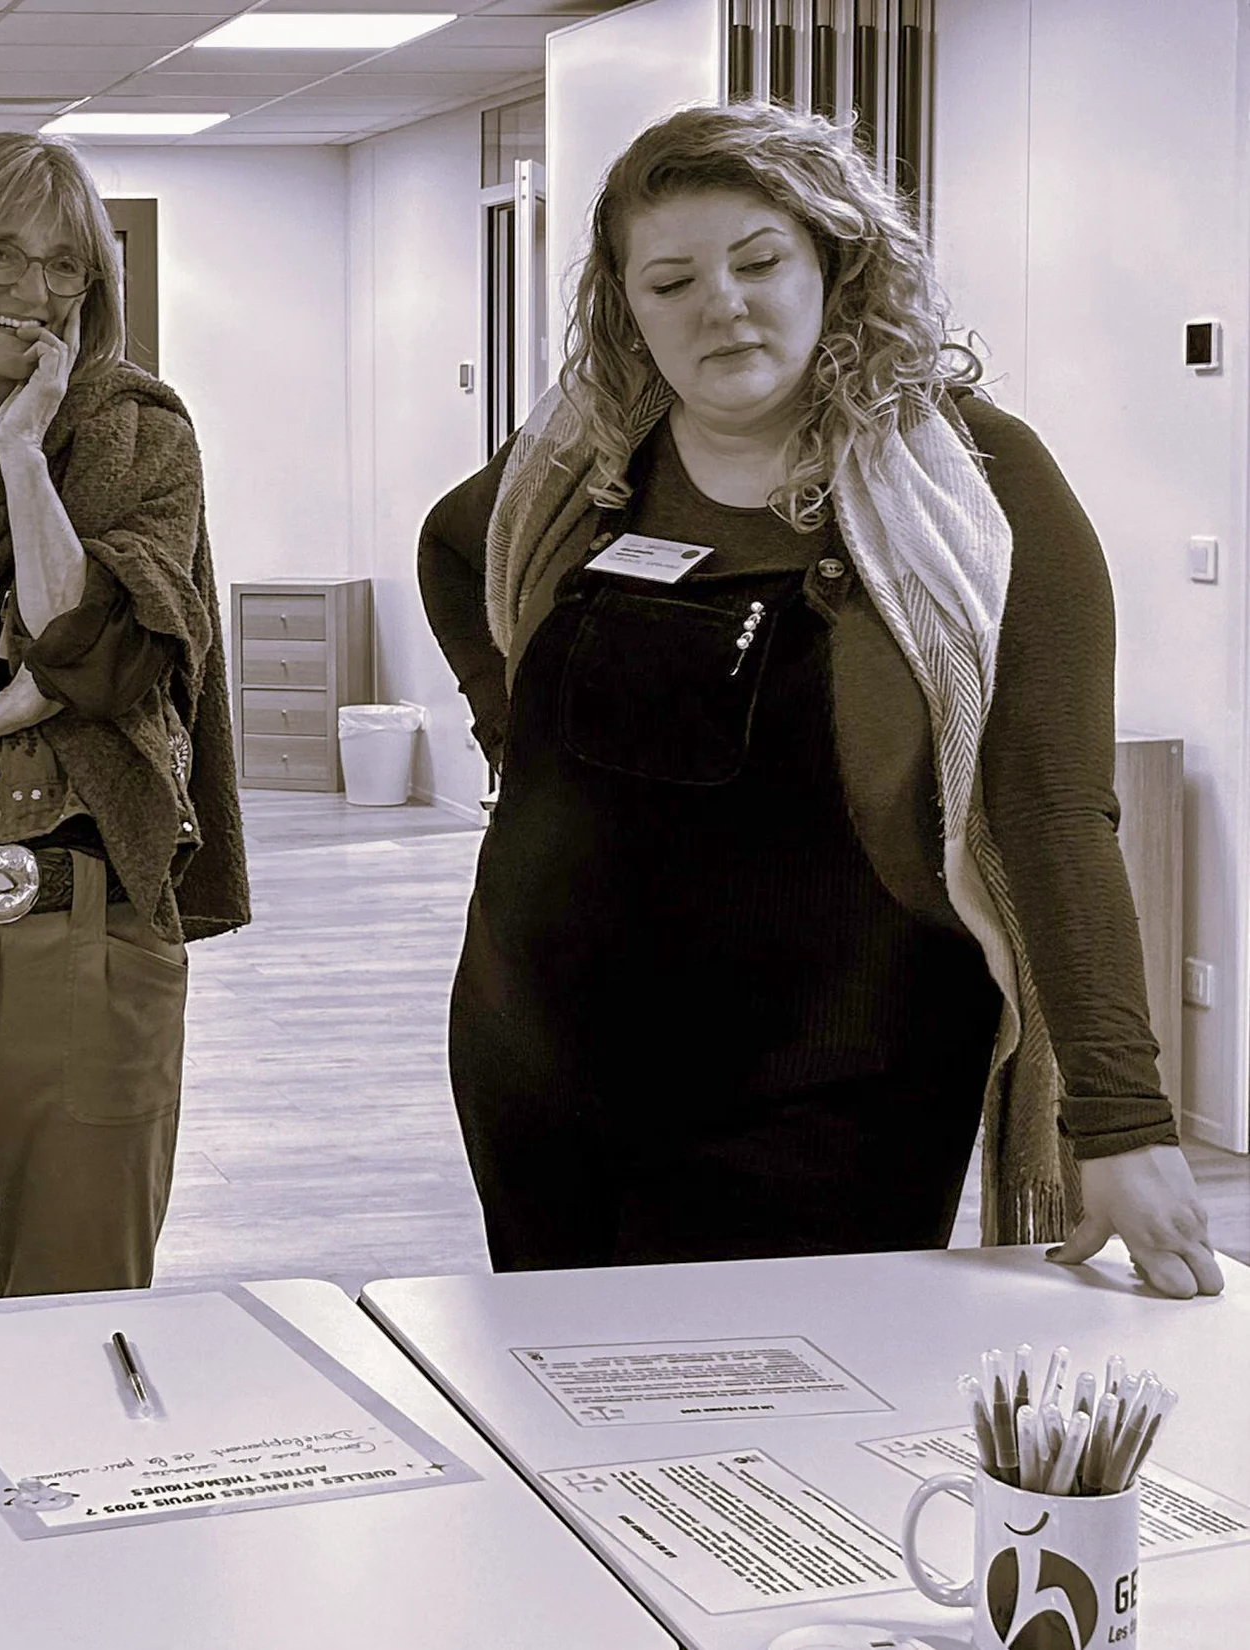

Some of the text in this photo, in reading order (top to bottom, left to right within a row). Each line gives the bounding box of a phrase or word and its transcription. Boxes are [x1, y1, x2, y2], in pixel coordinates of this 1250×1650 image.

[147, 1456, 168, 1468] la
[171, 1451, 195, 1462] de
[130, 1464, 327, 1497] AUTRES THÉMATIQUES
[85, 1469, 397, 1516] QUELLES AVANCÉES DEPUIS 2005 ?
[1108, 1625, 1128, 1643] Les
